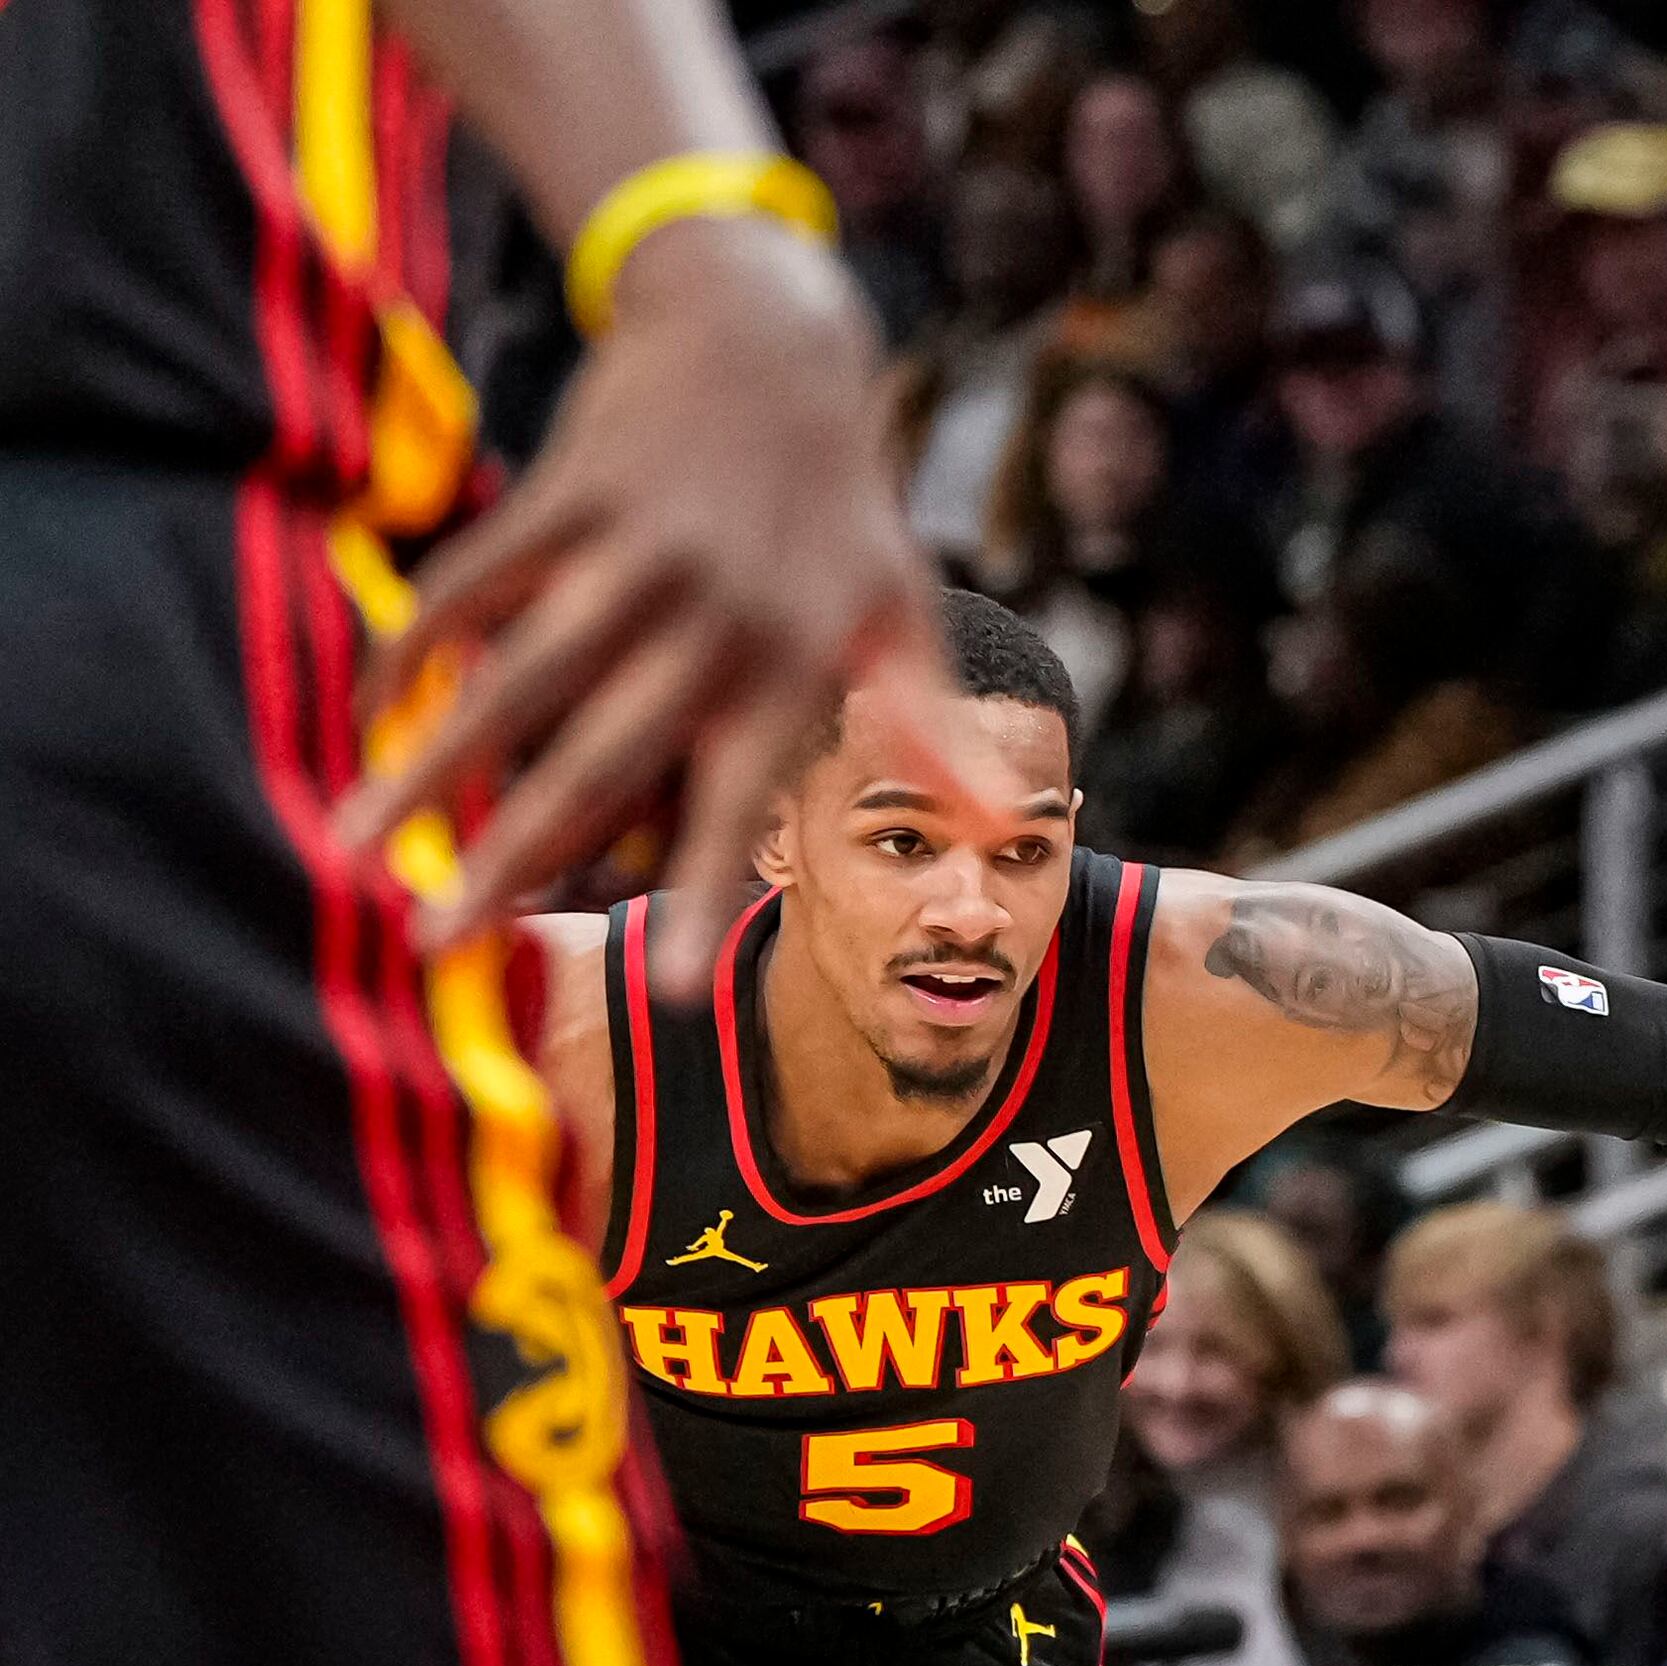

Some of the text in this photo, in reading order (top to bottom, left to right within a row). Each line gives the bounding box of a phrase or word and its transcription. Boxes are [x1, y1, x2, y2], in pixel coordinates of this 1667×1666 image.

[982, 1184, 1022, 1205] the
[621, 1266, 1130, 1399] HAWKS
[799, 1418, 975, 1536] 5
